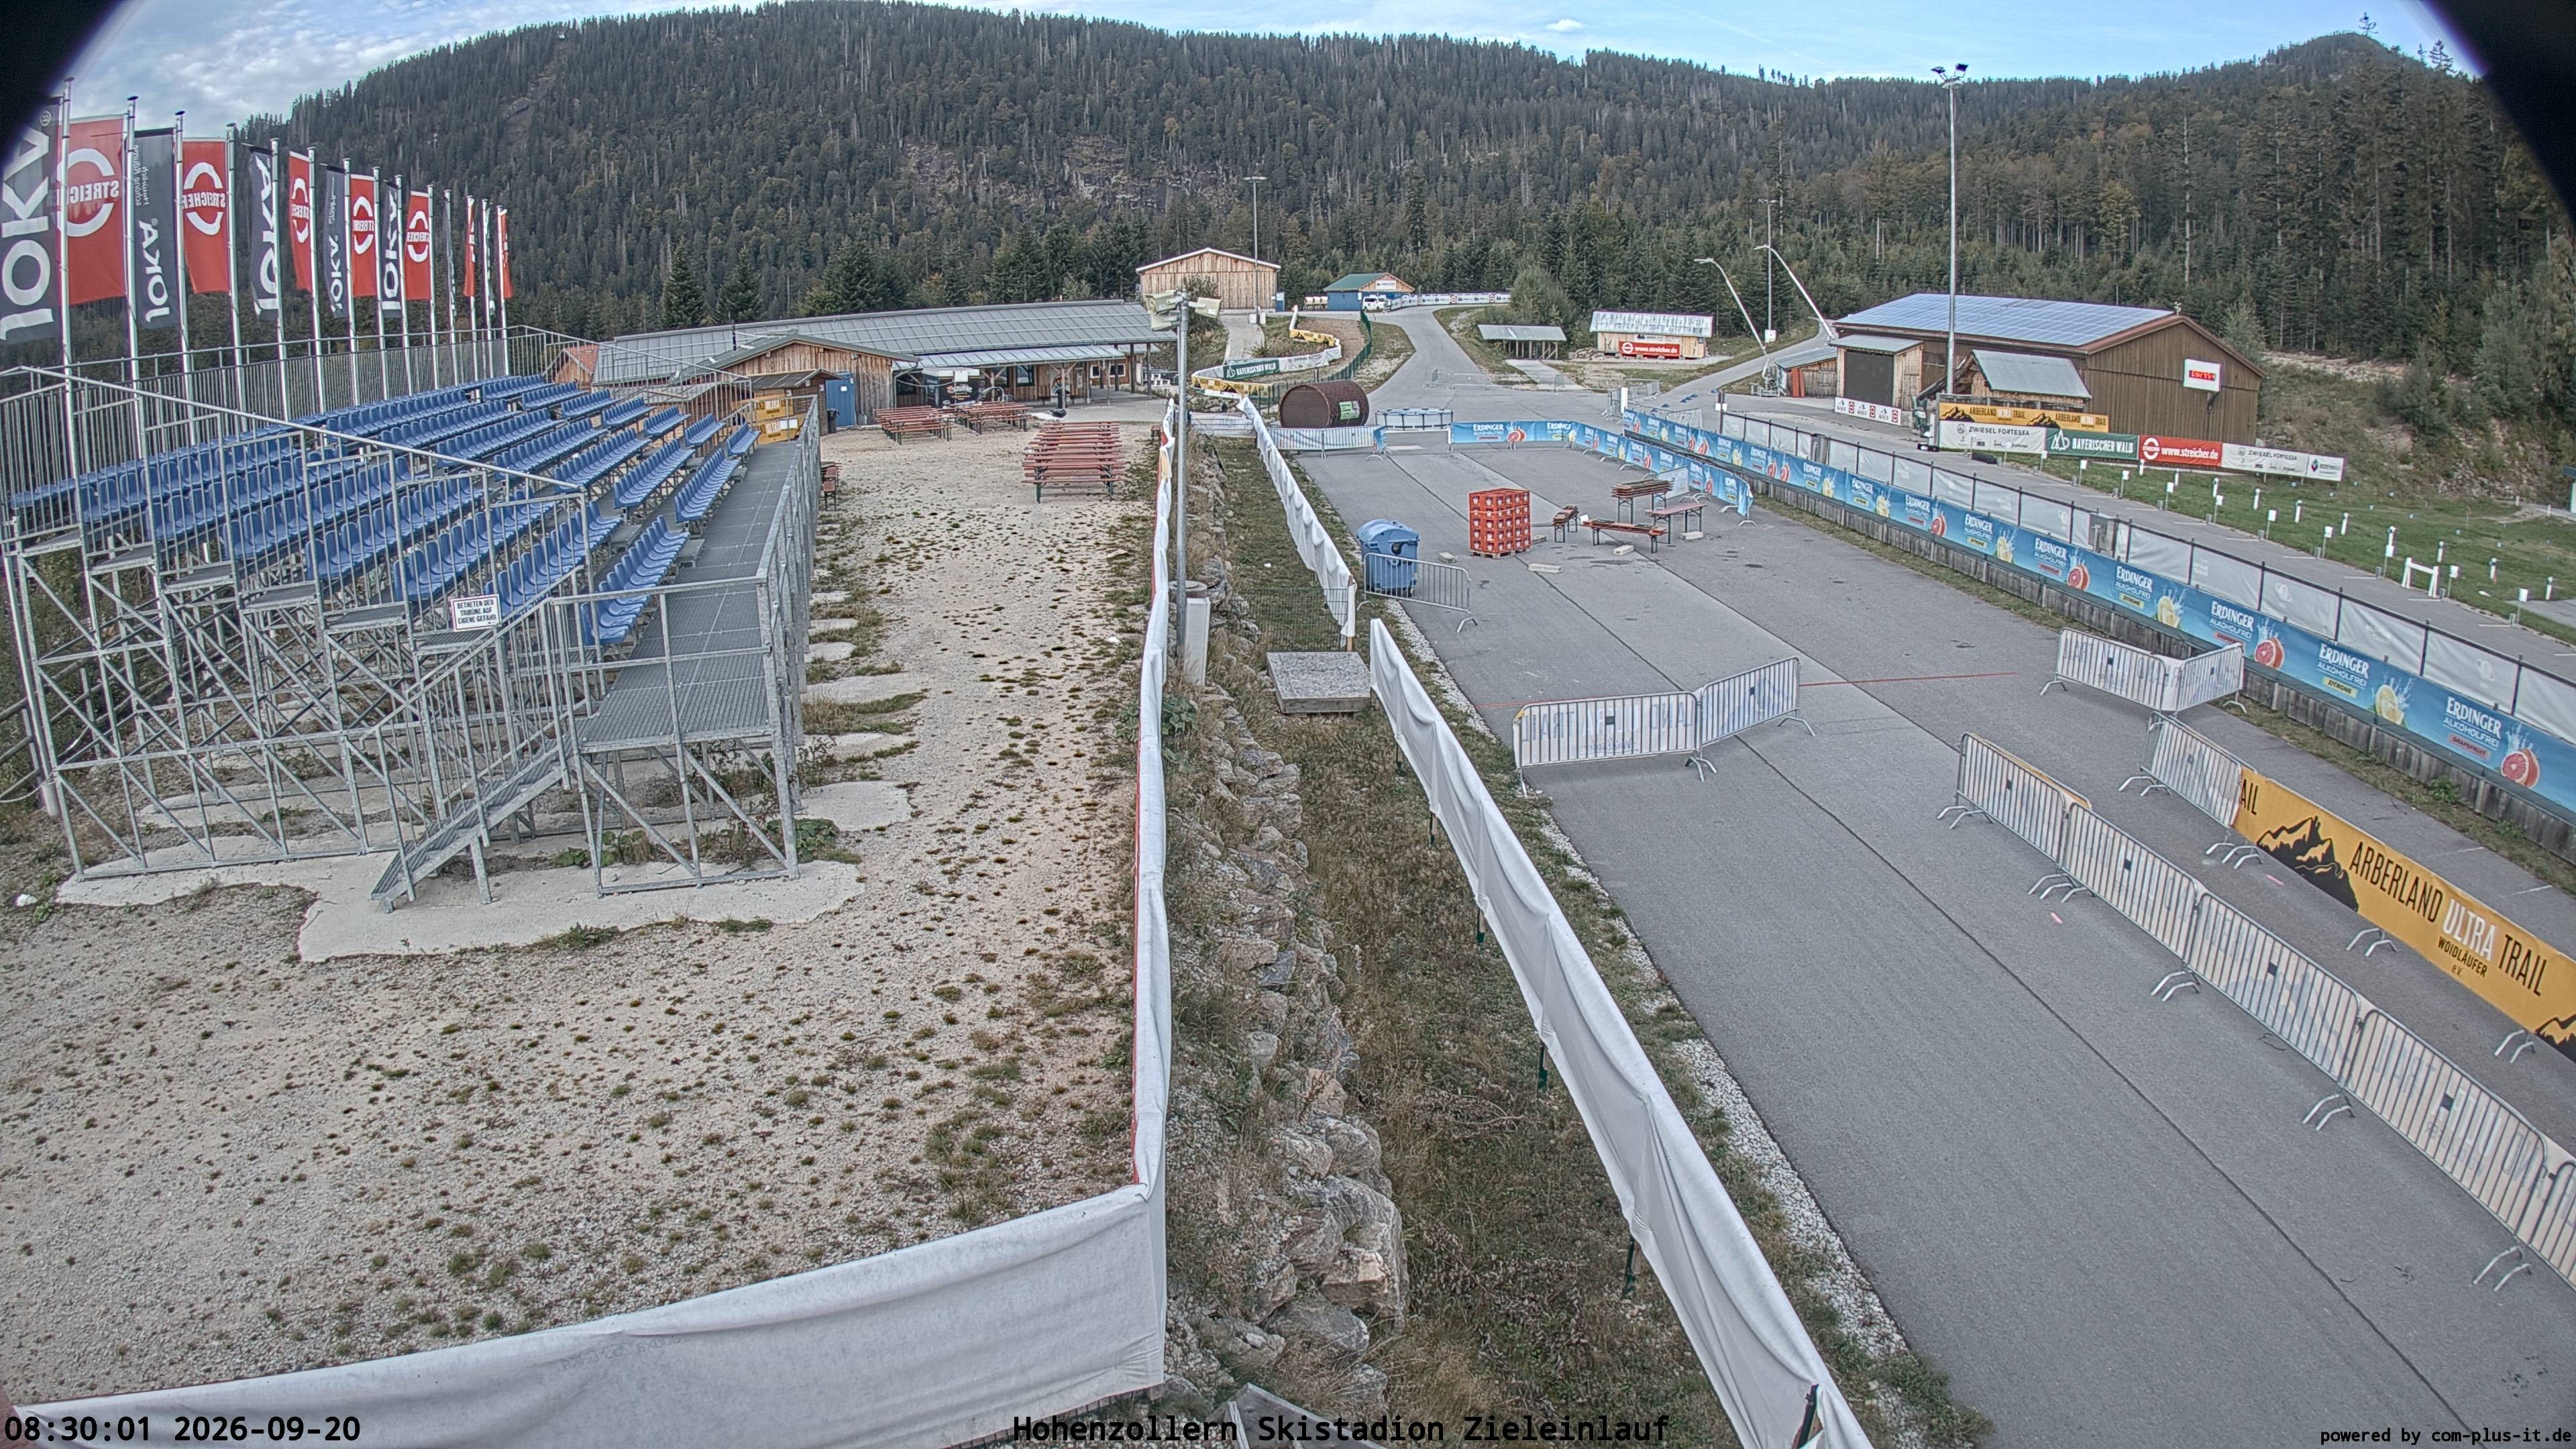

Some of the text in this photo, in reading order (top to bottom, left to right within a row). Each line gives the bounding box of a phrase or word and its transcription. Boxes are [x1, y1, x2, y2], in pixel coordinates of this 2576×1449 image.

[1970, 407, 1996, 417] ARBERLAND
[1969, 426, 1996, 434] ZWIESEL
[2072, 437, 2114, 451] BAYERISCHER
[2116, 441, 2134, 453] WALD
[2161, 447, 2219, 460] www.streicher.de
[2035, 537, 2067, 561] ERDINGER
[2116, 566, 2152, 592] ERDINGER
[457, 600, 483, 609] BETRETEN
[2211, 601, 2254, 632] ERDINGER
[2317, 661, 2367, 688] ALKOHOLFREI
[2319, 643, 2369, 680] ERDINGER
[2328, 680, 2352, 694] ZITRONE
[2447, 696, 2502, 739] ERDINGER
[2444, 716, 2500, 748] ALKOHOLFREI
[2349, 841, 2548, 997] ARBERLAND ULTRA TRAIL
[2438, 935, 2488, 979] WOIDLÄUFER
